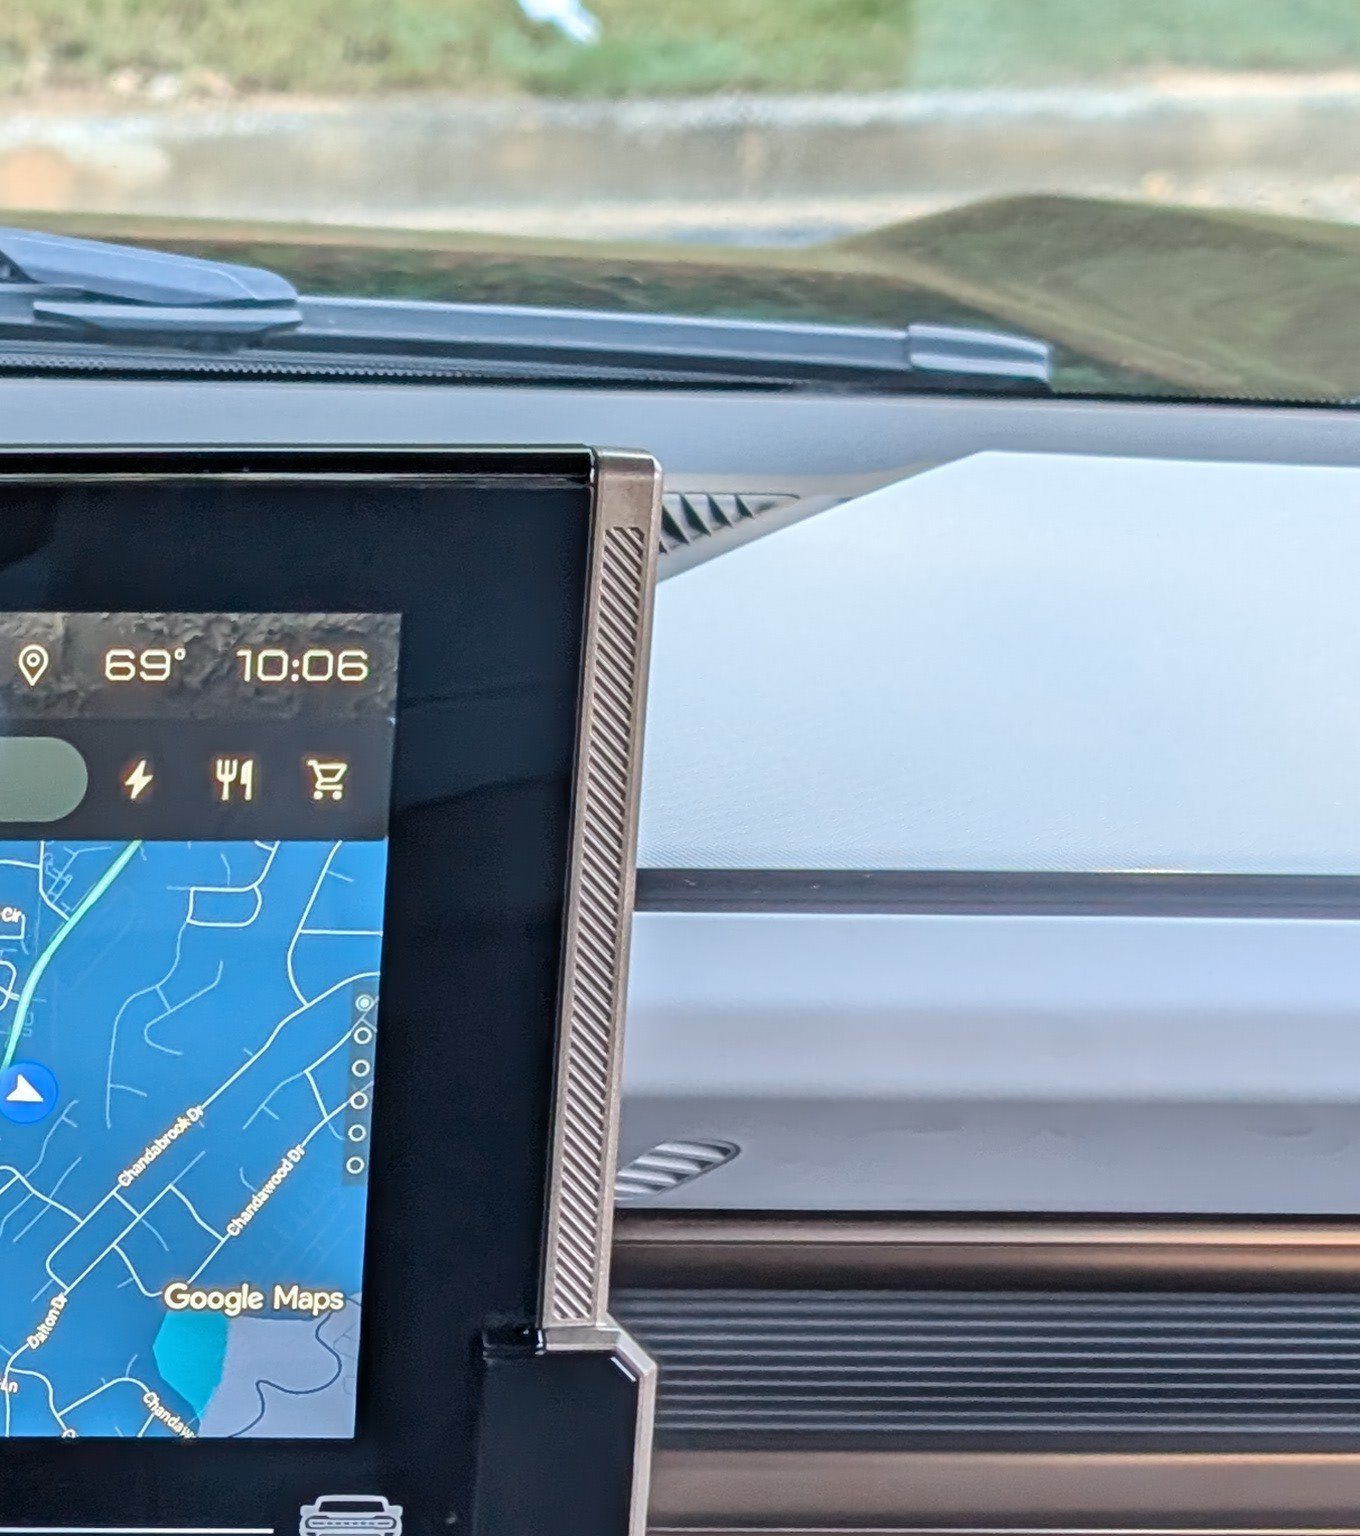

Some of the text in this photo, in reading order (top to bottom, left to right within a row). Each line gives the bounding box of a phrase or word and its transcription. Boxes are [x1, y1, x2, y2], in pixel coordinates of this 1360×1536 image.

[104, 647, 369, 682] 69° 10:06
[2, 906, 22, 923] Cir
[117, 1104, 204, 1187] Chandabrook Dr
[226, 1143, 306, 1237] Chandawood Dr
[164, 1282, 345, 1316] Google Maps
